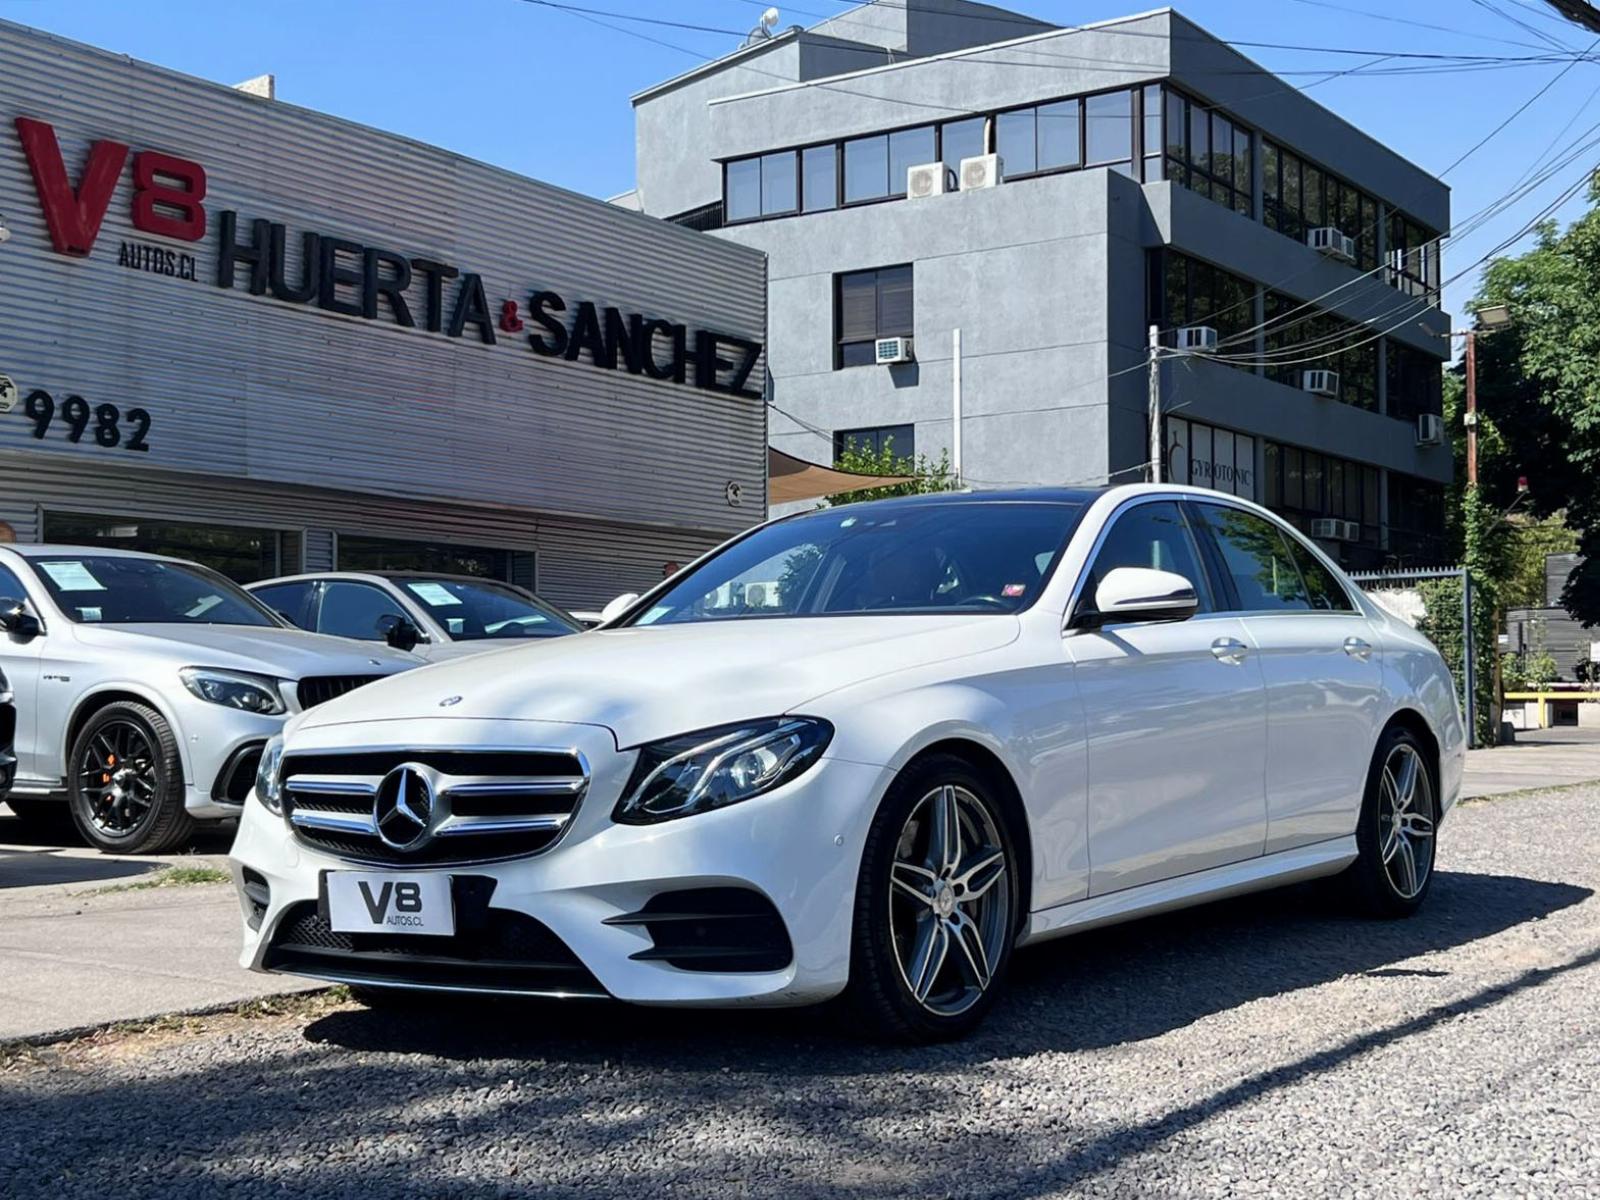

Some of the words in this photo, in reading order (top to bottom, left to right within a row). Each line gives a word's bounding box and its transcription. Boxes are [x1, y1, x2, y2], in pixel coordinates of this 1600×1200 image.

[14, 116, 207, 258] V8
[119, 241, 199, 282] AUTOS.CL
[217, 210, 496, 345] HUERTA
[500, 300, 523, 332] &
[528, 290, 762, 399] SANCHEZ
[25, 389, 151, 451] 9982
[358, 881, 422, 924] V8
[386, 915, 424, 927] AUTOS.CL
